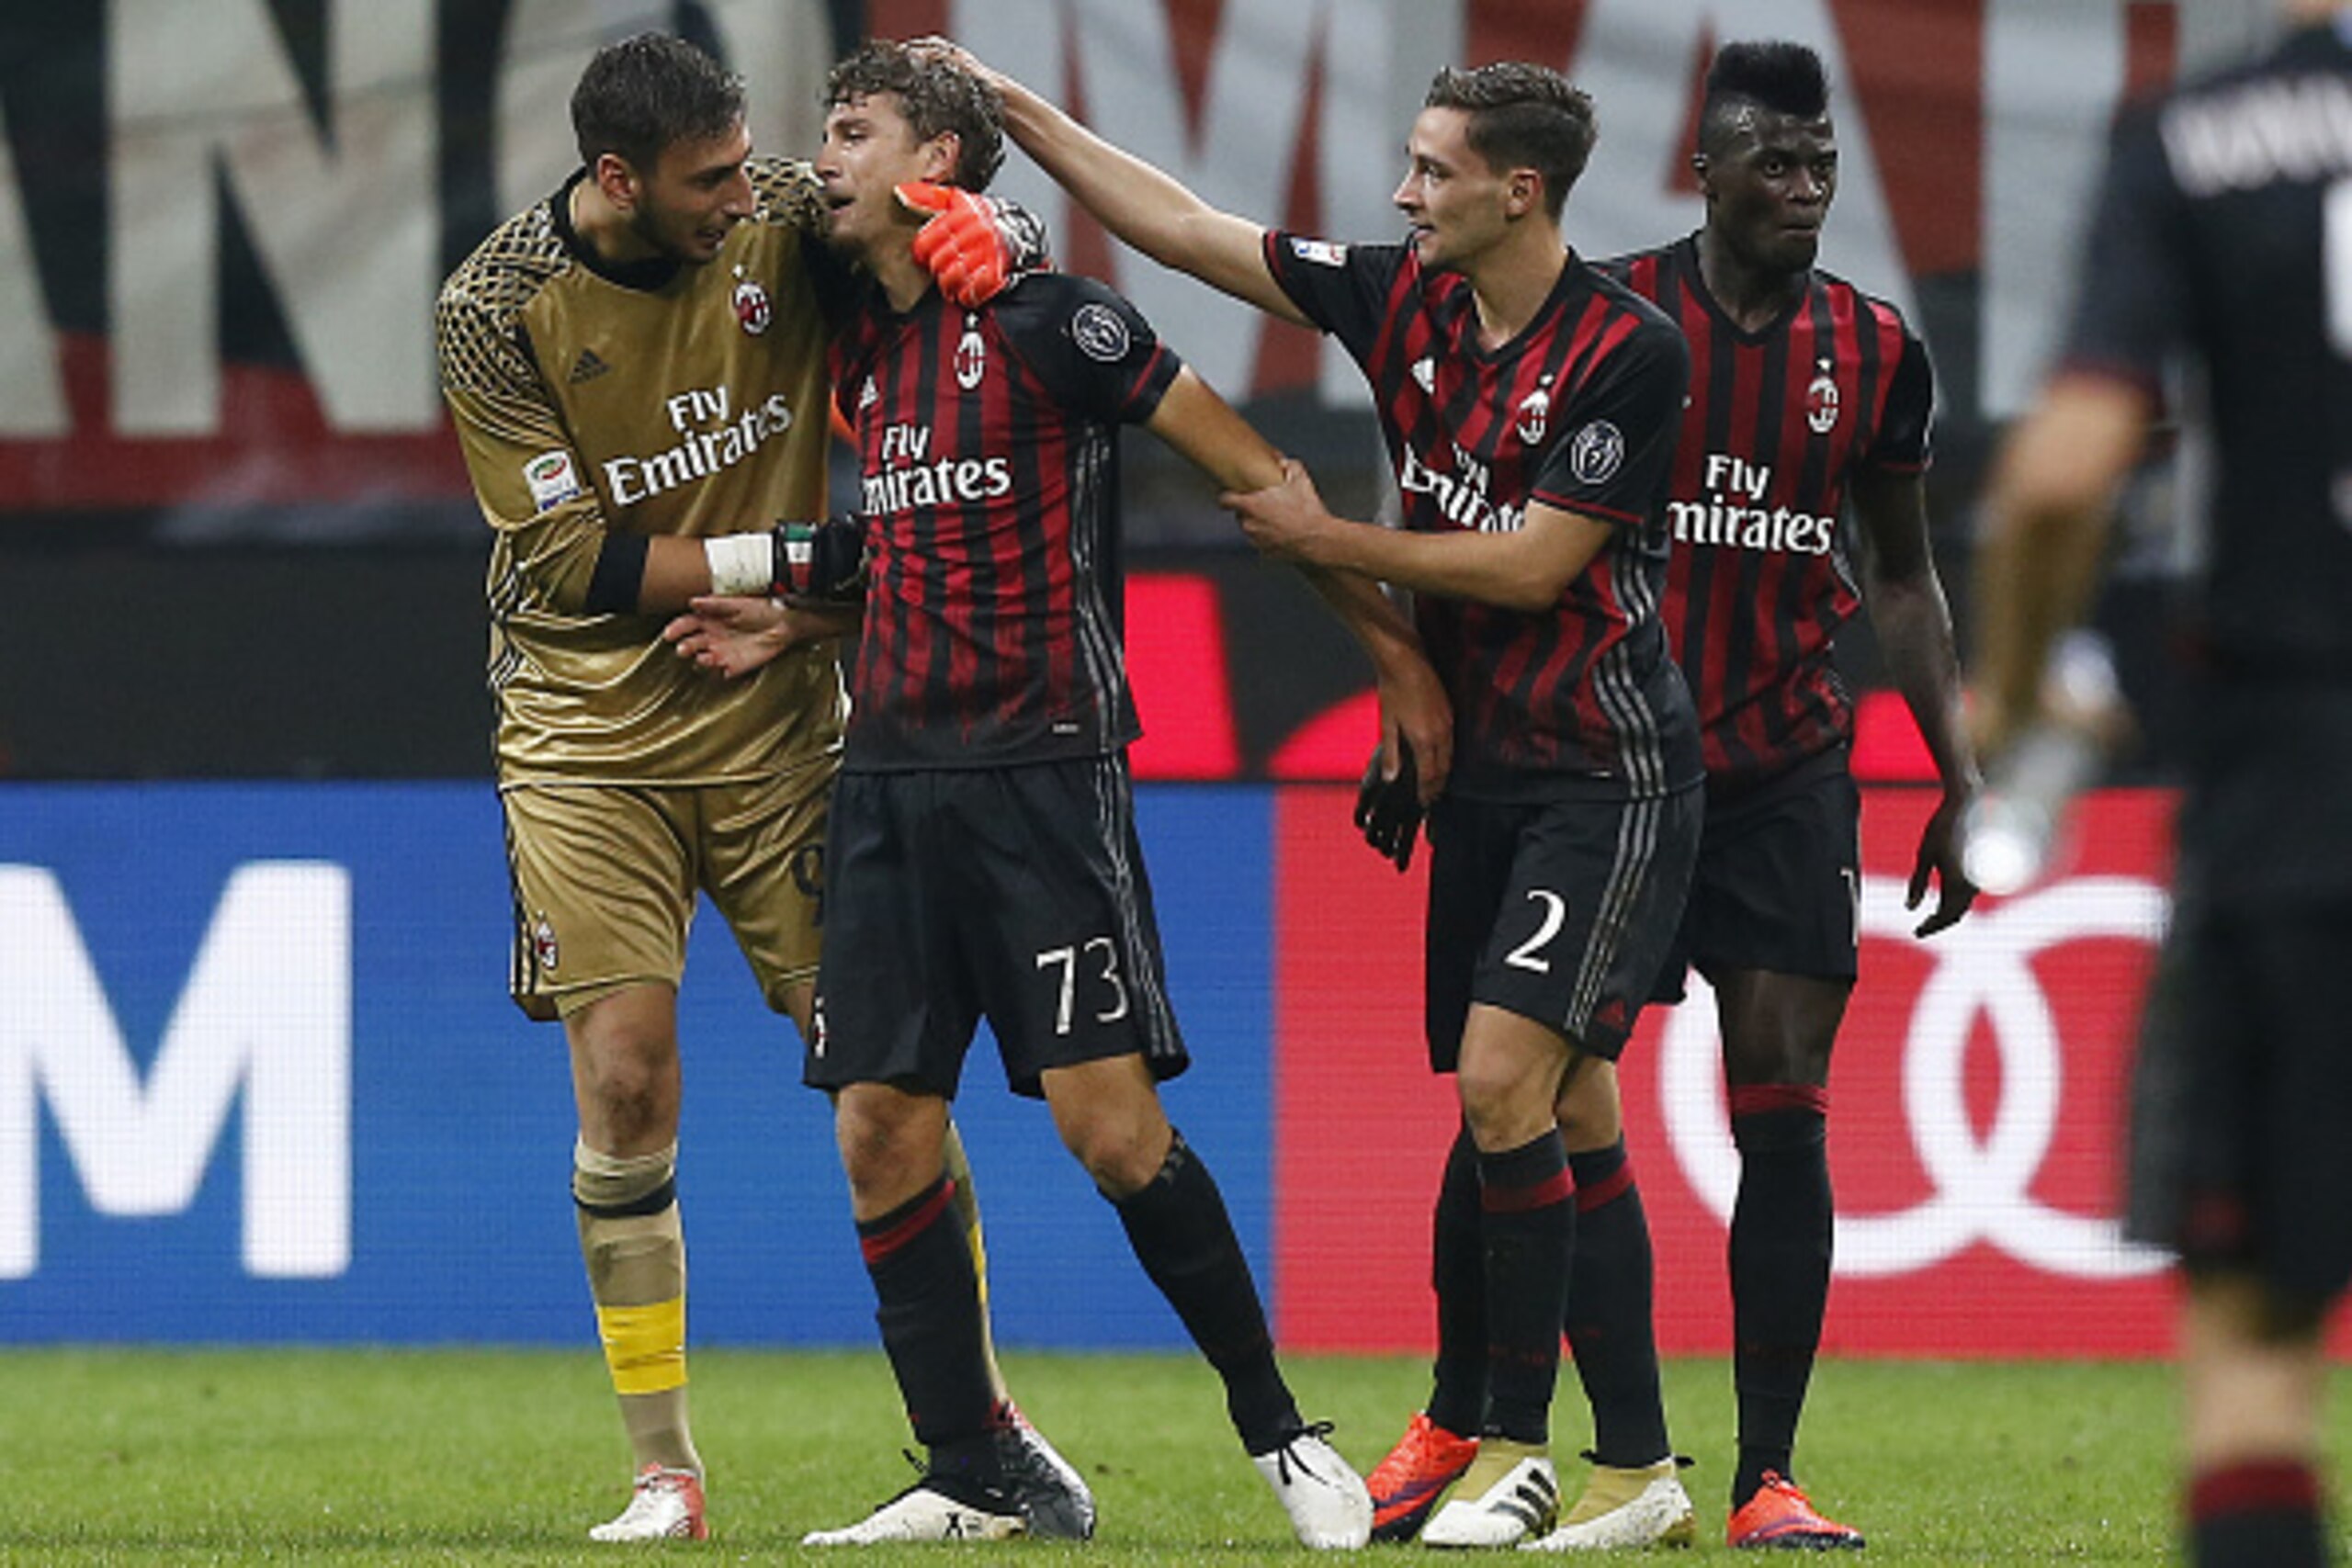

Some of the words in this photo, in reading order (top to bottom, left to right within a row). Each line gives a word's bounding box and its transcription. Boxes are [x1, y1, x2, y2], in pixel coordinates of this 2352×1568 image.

[666, 384, 731, 432] Fly
[602, 393, 793, 505] Emirates
[882, 423, 930, 460] Fly
[862, 456, 1012, 516] mirates
[1705, 455, 1770, 500] Fly
[1667, 494, 1835, 555] mirates
[1505, 889, 1566, 973] 2
[1036, 937, 1128, 1034] 73
